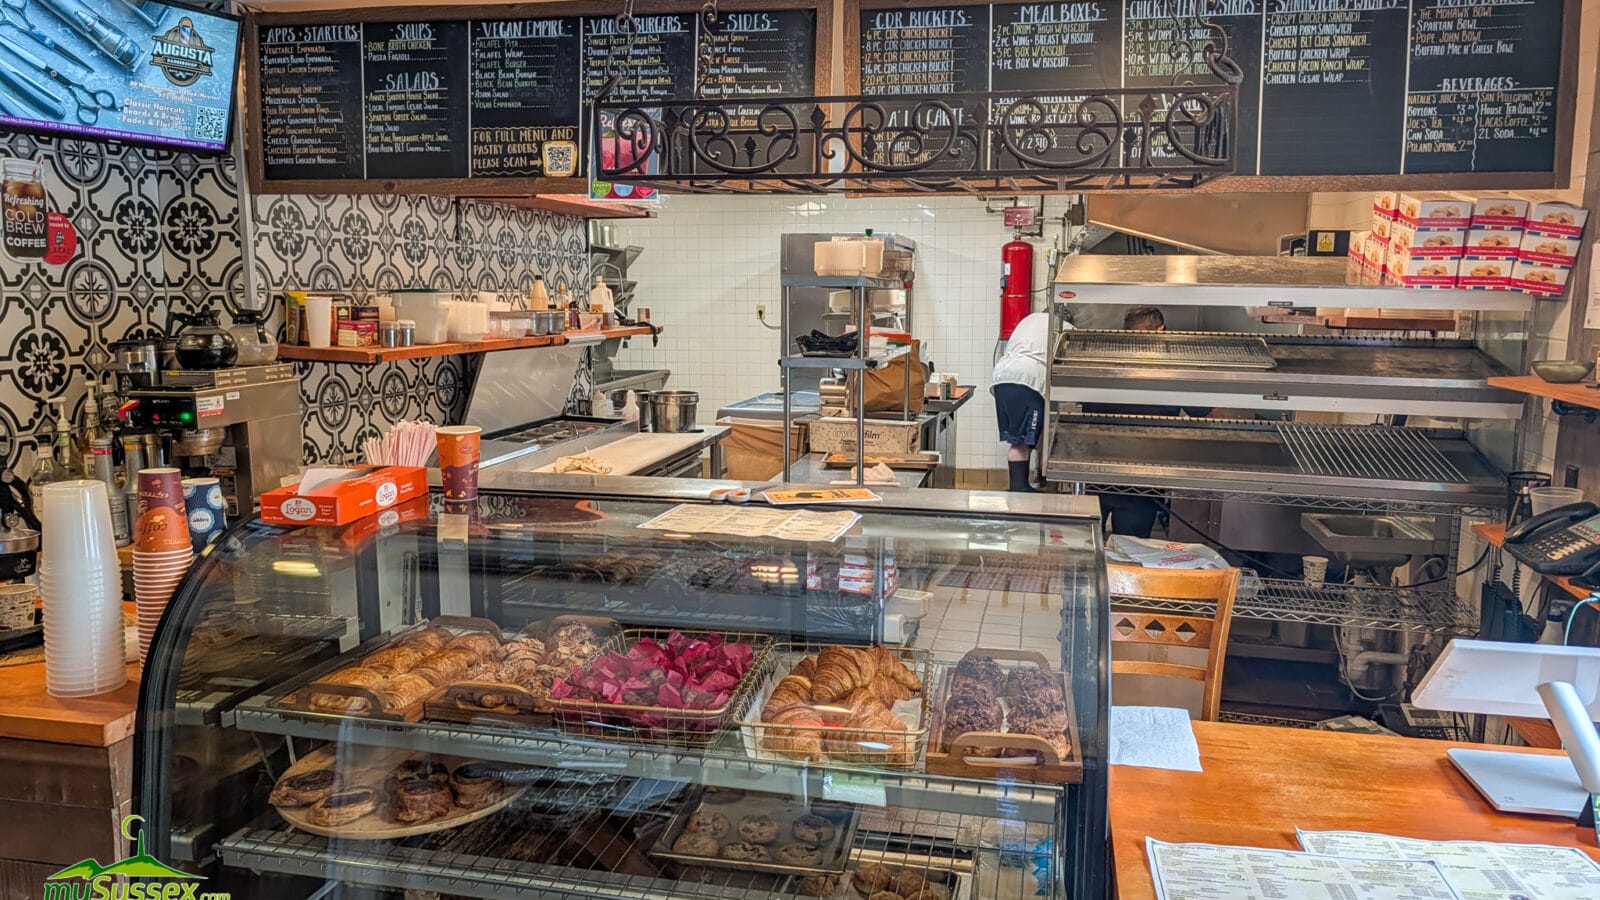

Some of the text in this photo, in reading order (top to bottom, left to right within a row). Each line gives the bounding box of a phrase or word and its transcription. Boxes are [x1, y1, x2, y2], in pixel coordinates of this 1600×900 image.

[1020, 2, 1100, 23] MEAL BOXES
[1271, 12, 1360, 25] CRISPY CHICKEN SANDWICH
[1420, 7, 1493, 20] THE MOHAWK BOWL
[634, 16, 681, 33] BURGERS
[727, 13, 771, 31] SIDES
[875, 10, 966, 28] CDR BUCKETS
[1129, 20, 1135, 30] 3
[395, 23, 432, 40] SOUPS
[481, 20, 565, 38] VEGAN EMPIRE
[996, 25, 1002, 35] 2
[1270, 24, 1352, 36] CHICKEN PARM SANDWICH
[1416, 19, 1478, 32] SPARTAN BOWL
[267, 25, 358, 43] APPS STARTERS
[901, 28, 953, 38] CHICKEN BUCKET
[1128, 29, 1211, 42] 5 PC SAUCE
[1416, 31, 1482, 43] POPE JOHN BOWL
[368, 40, 431, 51] BONE BROTH CHICKEN
[475, 39, 518, 48] FALAFEL PITA
[587, 35, 607, 45] SINGLE
[900, 39, 953, 50] CHICKEN BUCKET
[995, 34, 1060, 47] 2 WING BREAST
[1269, 35, 1367, 48] CHICKEN BLT CLUB SANDWICH
[153, 40, 211, 65] AUGUSTA
[264, 45, 293, 55] VEGETABLE
[475, 48, 523, 58] FALAFEL WRAP
[728, 43, 744, 53] FRIES
[996, 45, 1067, 58] 3 PC BOX BISCUIT
[1129, 43, 1144, 53] 8 PC
[1269, 48, 1351, 60] BUFFALO CHICKEN WRAP
[1414, 40, 1514, 56] BUFFALO MAC CHEESE BOWL
[368, 52, 386, 62] PASTA
[900, 50, 955, 61] CHICKEN BUCKET
[1128, 54, 1145, 65] 10 PC
[475, 59, 527, 69] FALAFEL BURGER
[898, 61, 954, 72] CHICKEN BUCKET
[997, 57, 1069, 69] 4 BOX BISCUIT
[1268, 59, 1365, 72] CHICKEN BACON RANCH WRAP
[475, 69, 514, 79] BLACK BEAN
[1129, 65, 1135, 76] 12
[386, 72, 439, 90] SALADS
[718, 75, 736, 83] BEANS
[901, 72, 954, 83] CHICKEN BUCKET
[1266, 71, 1344, 84] CHICKEN CESAR WRAP
[902, 83, 955, 94] CHICKEN BUCKET
[1442, 77, 1514, 92] BEVERAGES
[1408, 92, 1457, 105] NATALIE'S JUICE
[1480, 91, 1533, 102] SAN PELLEGRINO
[123, 107, 150, 116] Beards
[124, 98, 185, 113] Classic Haircuts
[1480, 102, 1535, 115] HOUSE TEA (COLD)
[123, 115, 145, 125] Fades
[1407, 116, 1443, 129] JOE'S TEA
[1479, 116, 1528, 127] LACAS COFFEE
[473, 128, 574, 142] FOR FULL MENU AND
[1406, 129, 1443, 141] CAN SODA
[1478, 128, 1514, 139] 2L SODA
[267, 136, 289, 144] CHEESE
[1407, 140, 1457, 152] POLAND SPRING
[267, 145, 291, 154] CHICKEN
[473, 143, 538, 155] PASTRY ORDERS
[472, 156, 528, 170] PLEASE SCAN
[5, 209, 44, 222] COLD
[6, 221, 45, 234] BREW
[7, 237, 47, 247] COFFEE
